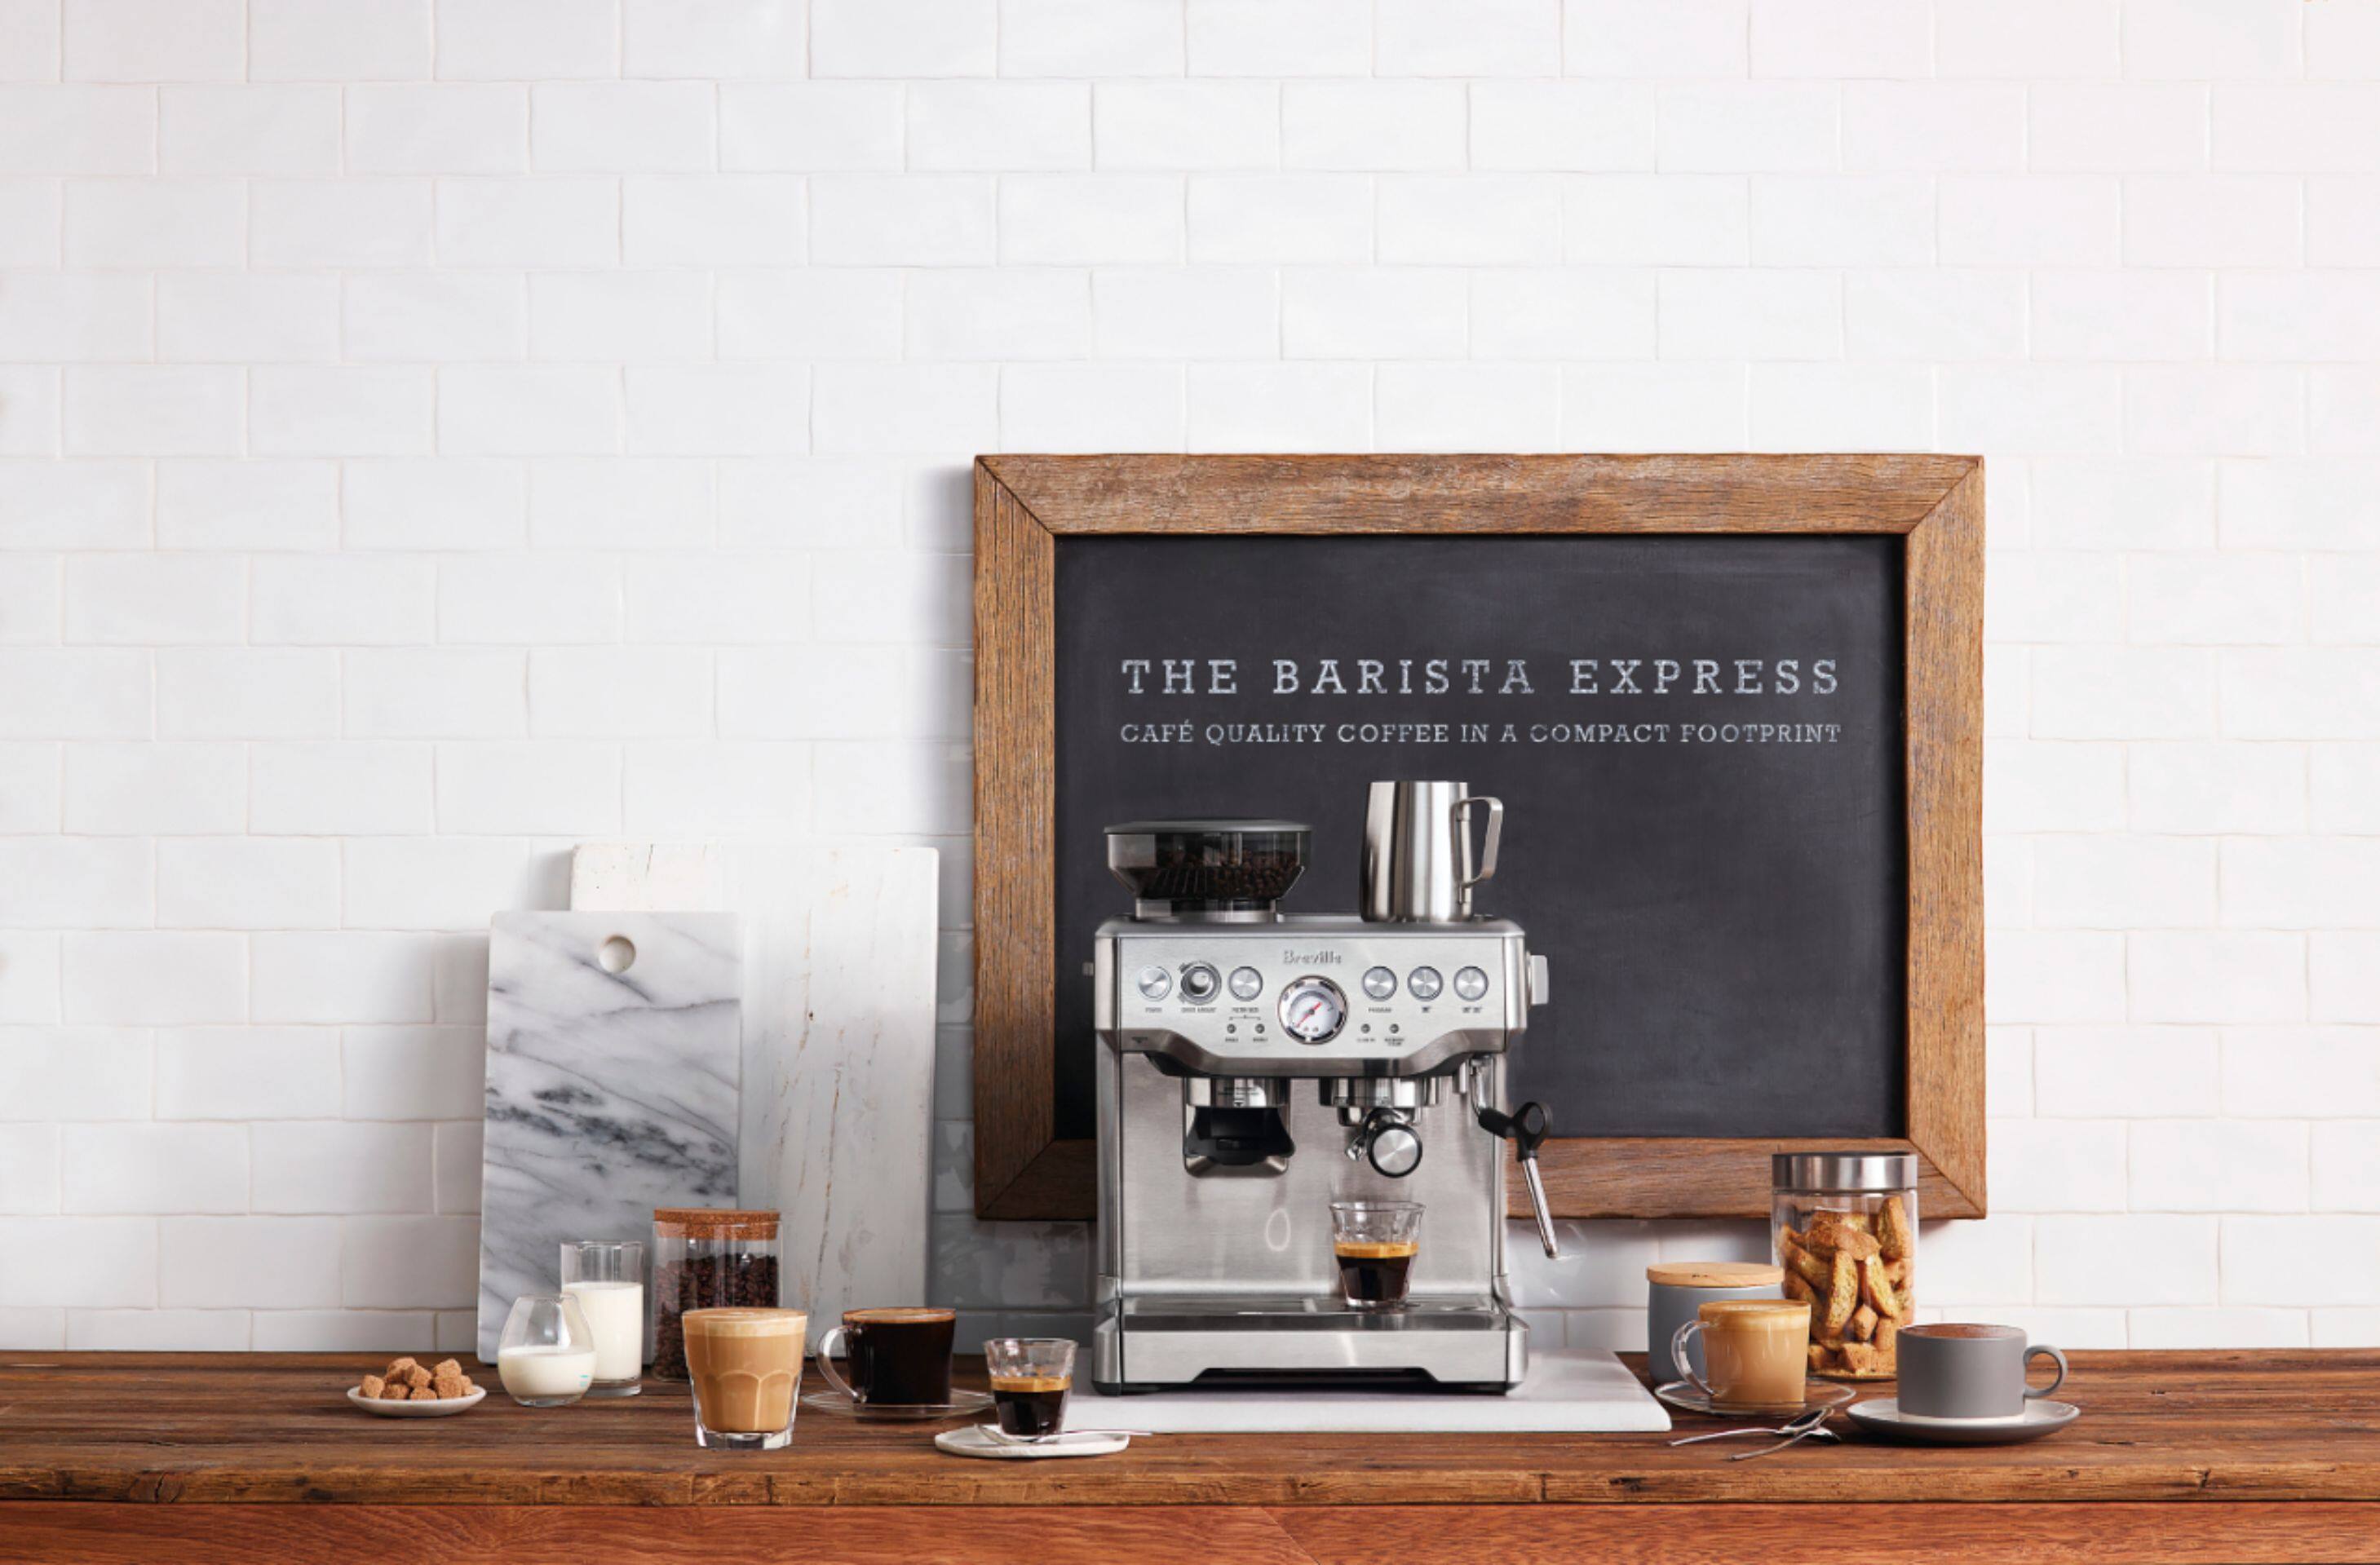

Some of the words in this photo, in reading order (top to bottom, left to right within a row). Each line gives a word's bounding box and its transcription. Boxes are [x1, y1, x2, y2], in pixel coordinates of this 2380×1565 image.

[1121, 659, 1238, 695] THE
[1272, 659, 1535, 695] BARISTA
[1569, 659, 1839, 695] EXPRESS
[1120, 719, 1194, 743] CAFÉ
[1205, 723, 1326, 747] QUALITY
[1336, 723, 1449, 743] COFFEE
[1461, 724, 1489, 743] IN
[1500, 724, 1519, 743] A
[1529, 723, 1670, 743] COMPACT
[1680, 723, 1842, 743] FOOTPRINT
[1284, 950, 1342, 964] Breville
